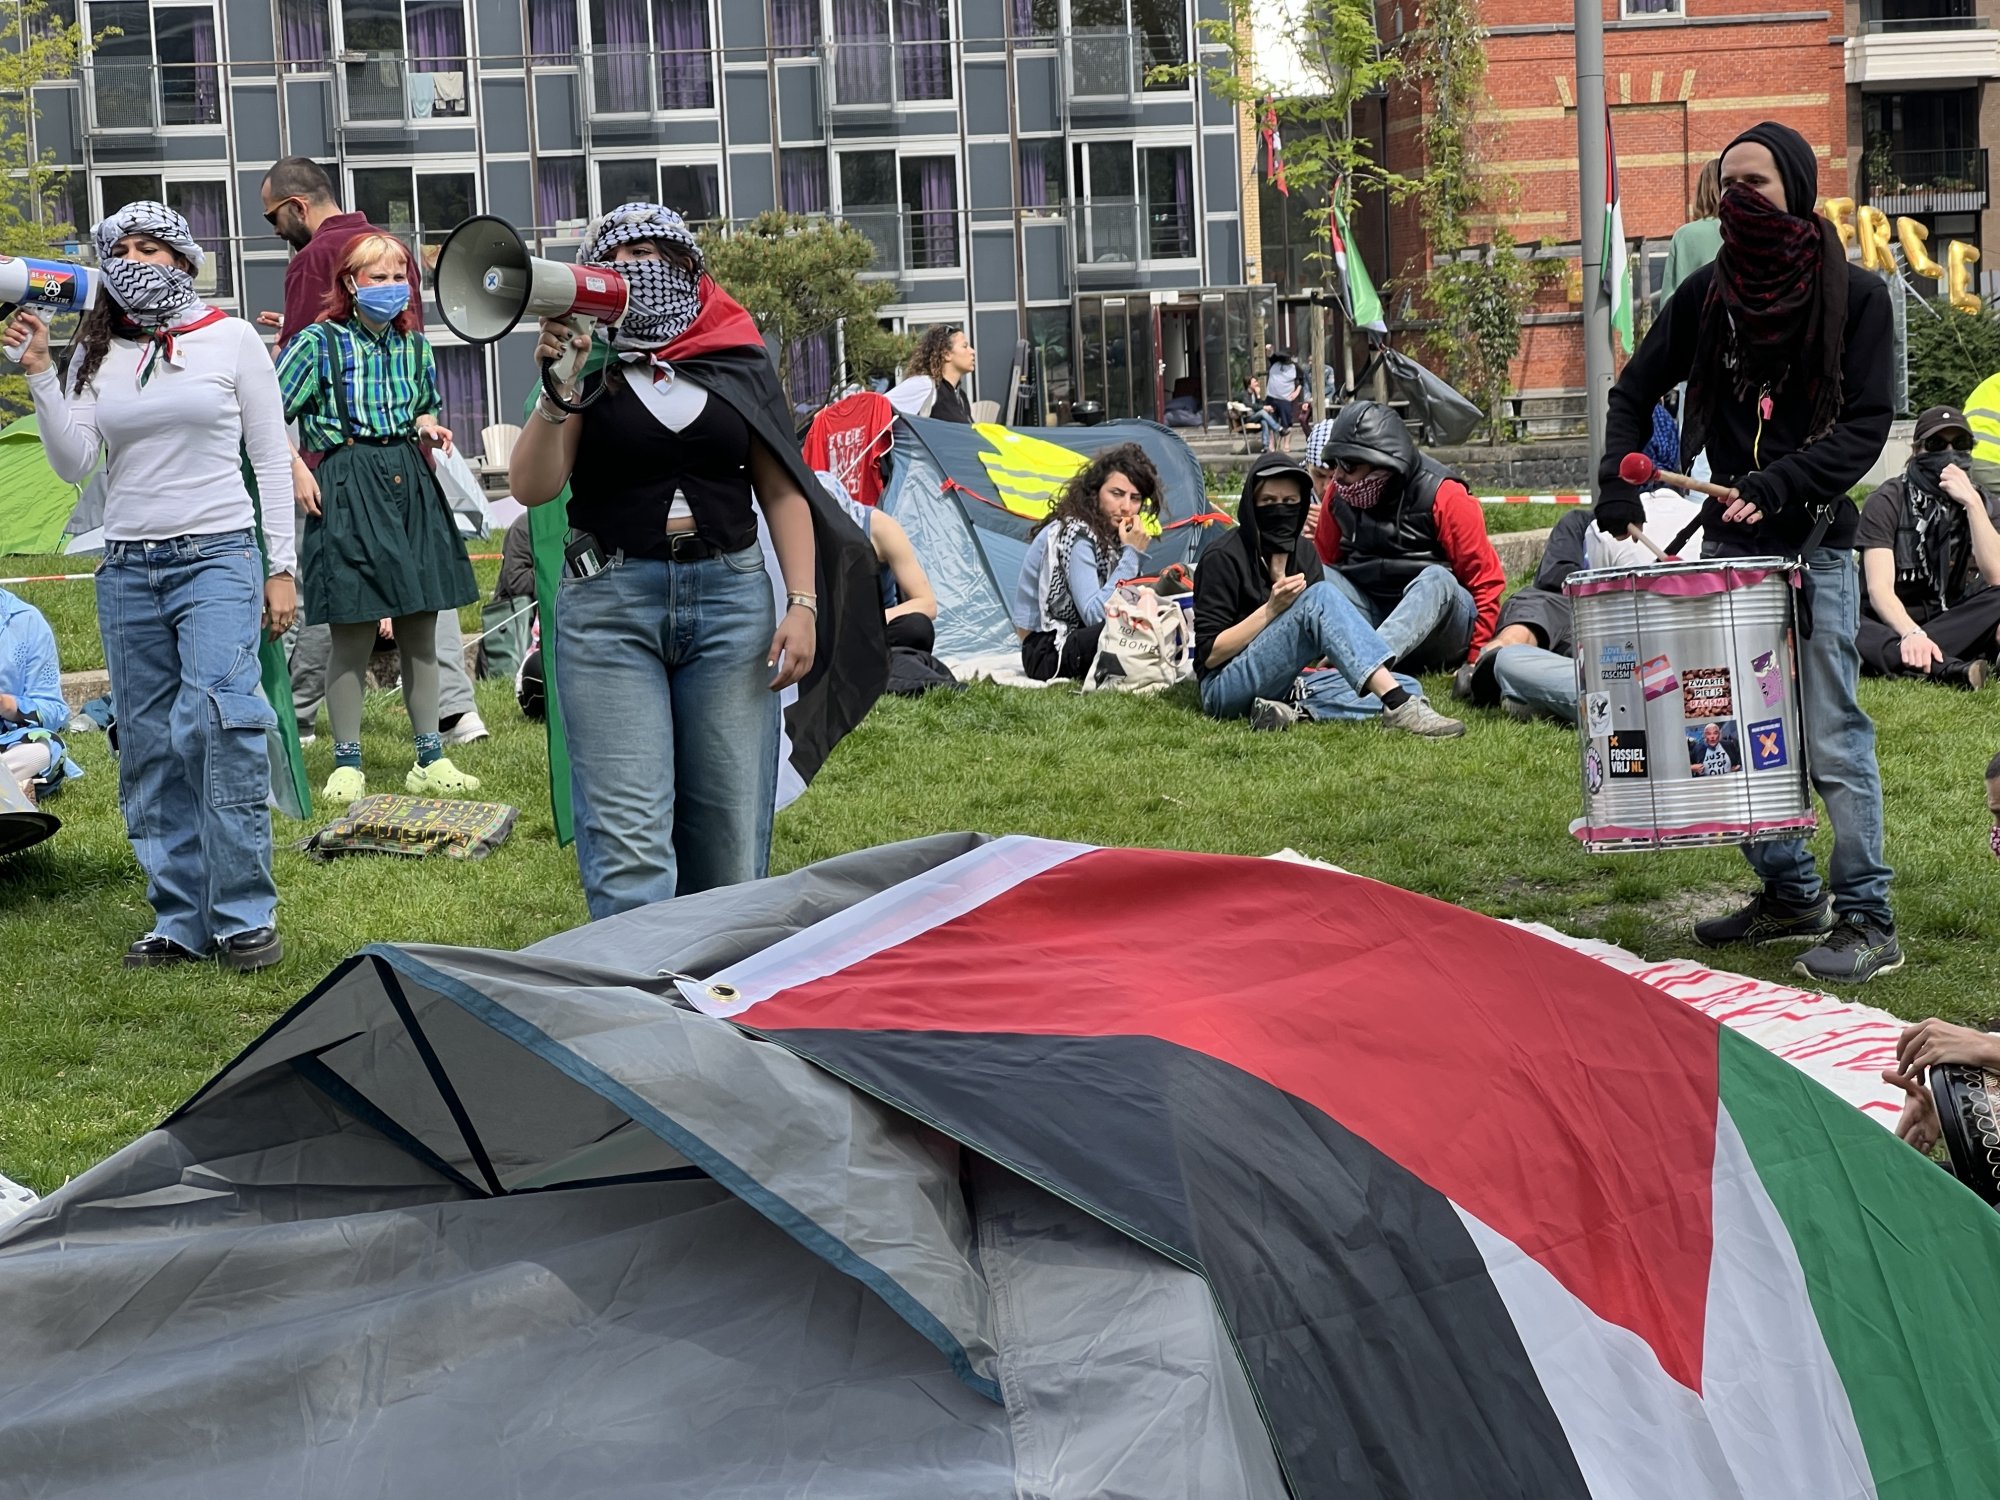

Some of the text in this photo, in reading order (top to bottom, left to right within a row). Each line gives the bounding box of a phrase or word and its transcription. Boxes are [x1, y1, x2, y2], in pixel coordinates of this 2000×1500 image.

[1824, 197, 1982, 315] FREE
[1691, 699, 1728, 707] RACISME
[1610, 749, 1645, 760] FOSSIEL
[1705, 752, 1726, 761] JUST
[1611, 761, 1644, 772] VRIJ NL
[1708, 760, 1727, 768] STOP
